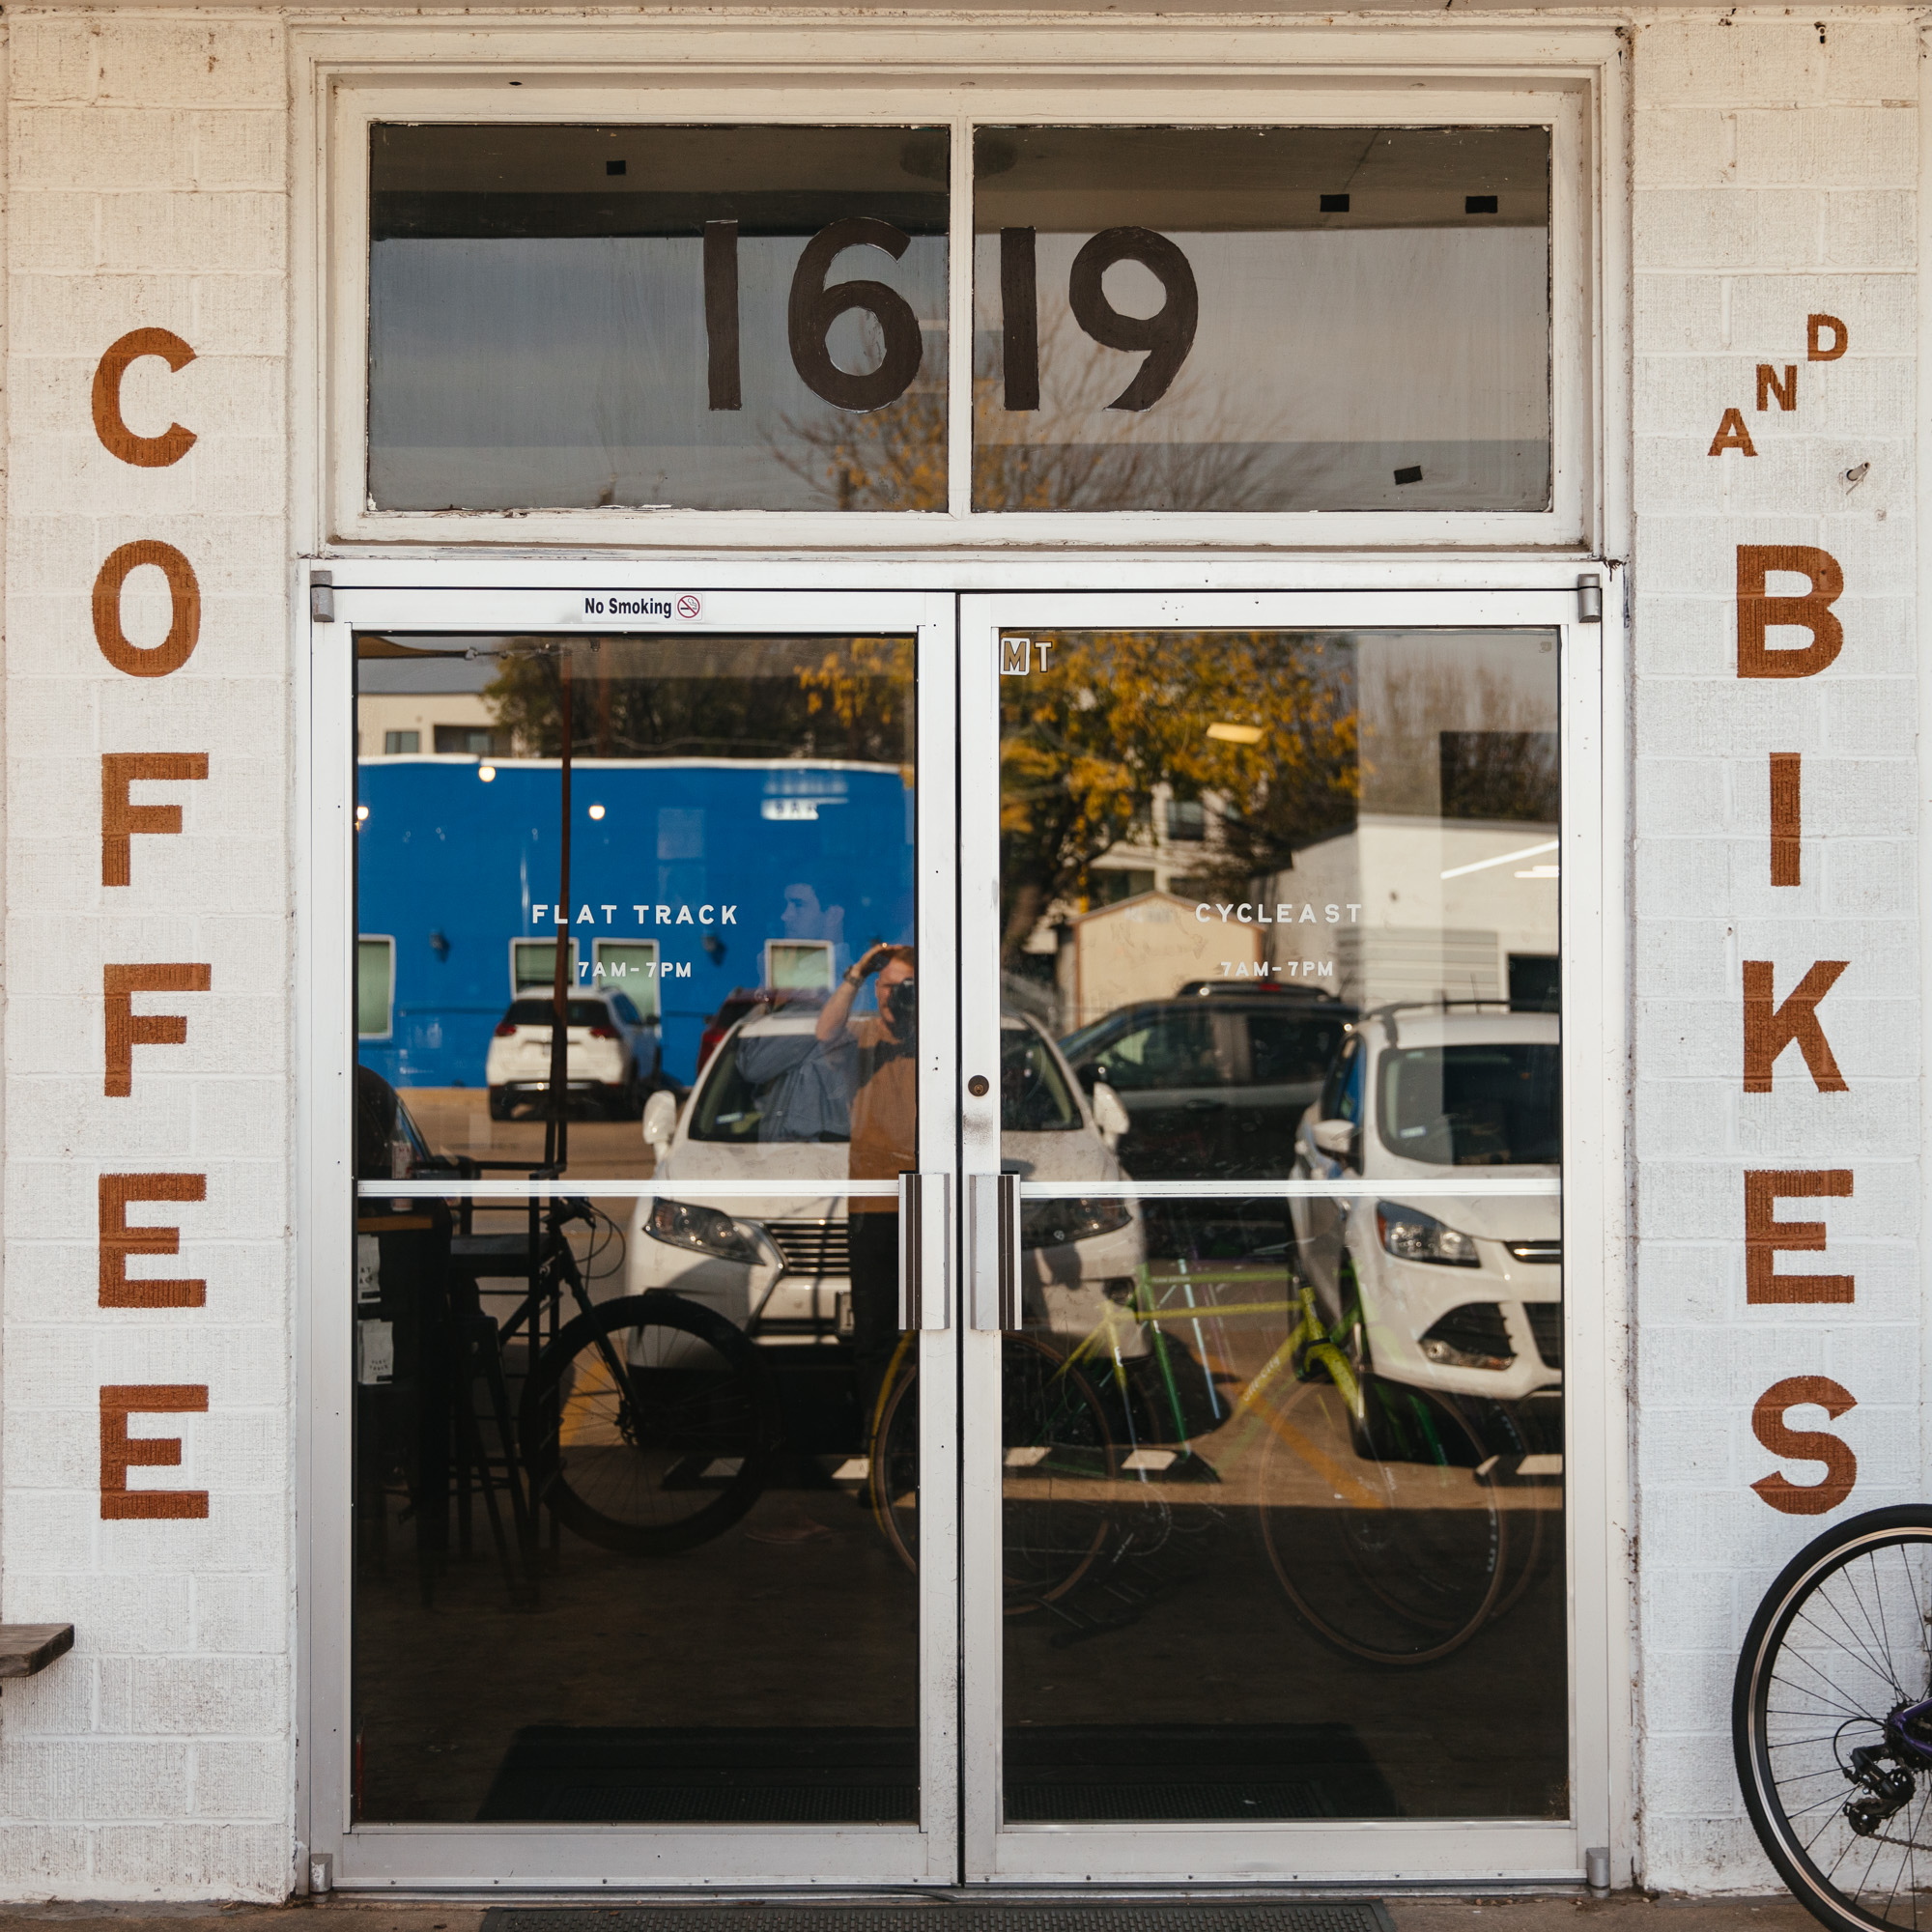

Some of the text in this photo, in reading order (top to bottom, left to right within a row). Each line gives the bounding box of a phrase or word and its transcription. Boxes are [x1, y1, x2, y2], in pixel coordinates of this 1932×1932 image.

[702, 216, 1199, 414] 1619
[1708, 313, 1849, 457] AND
[584, 597, 672, 619] No Smoking
[92, 327, 211, 1520] COFFEE
[531, 904, 739, 924] FLAT TRACK
[1195, 903, 1363, 923] CYCLEAST
[578, 961, 693, 978] 7AM-7PM
[1220, 961, 1335, 978] 7AM-7PM
[1737, 544, 1857, 1516] BIKES
